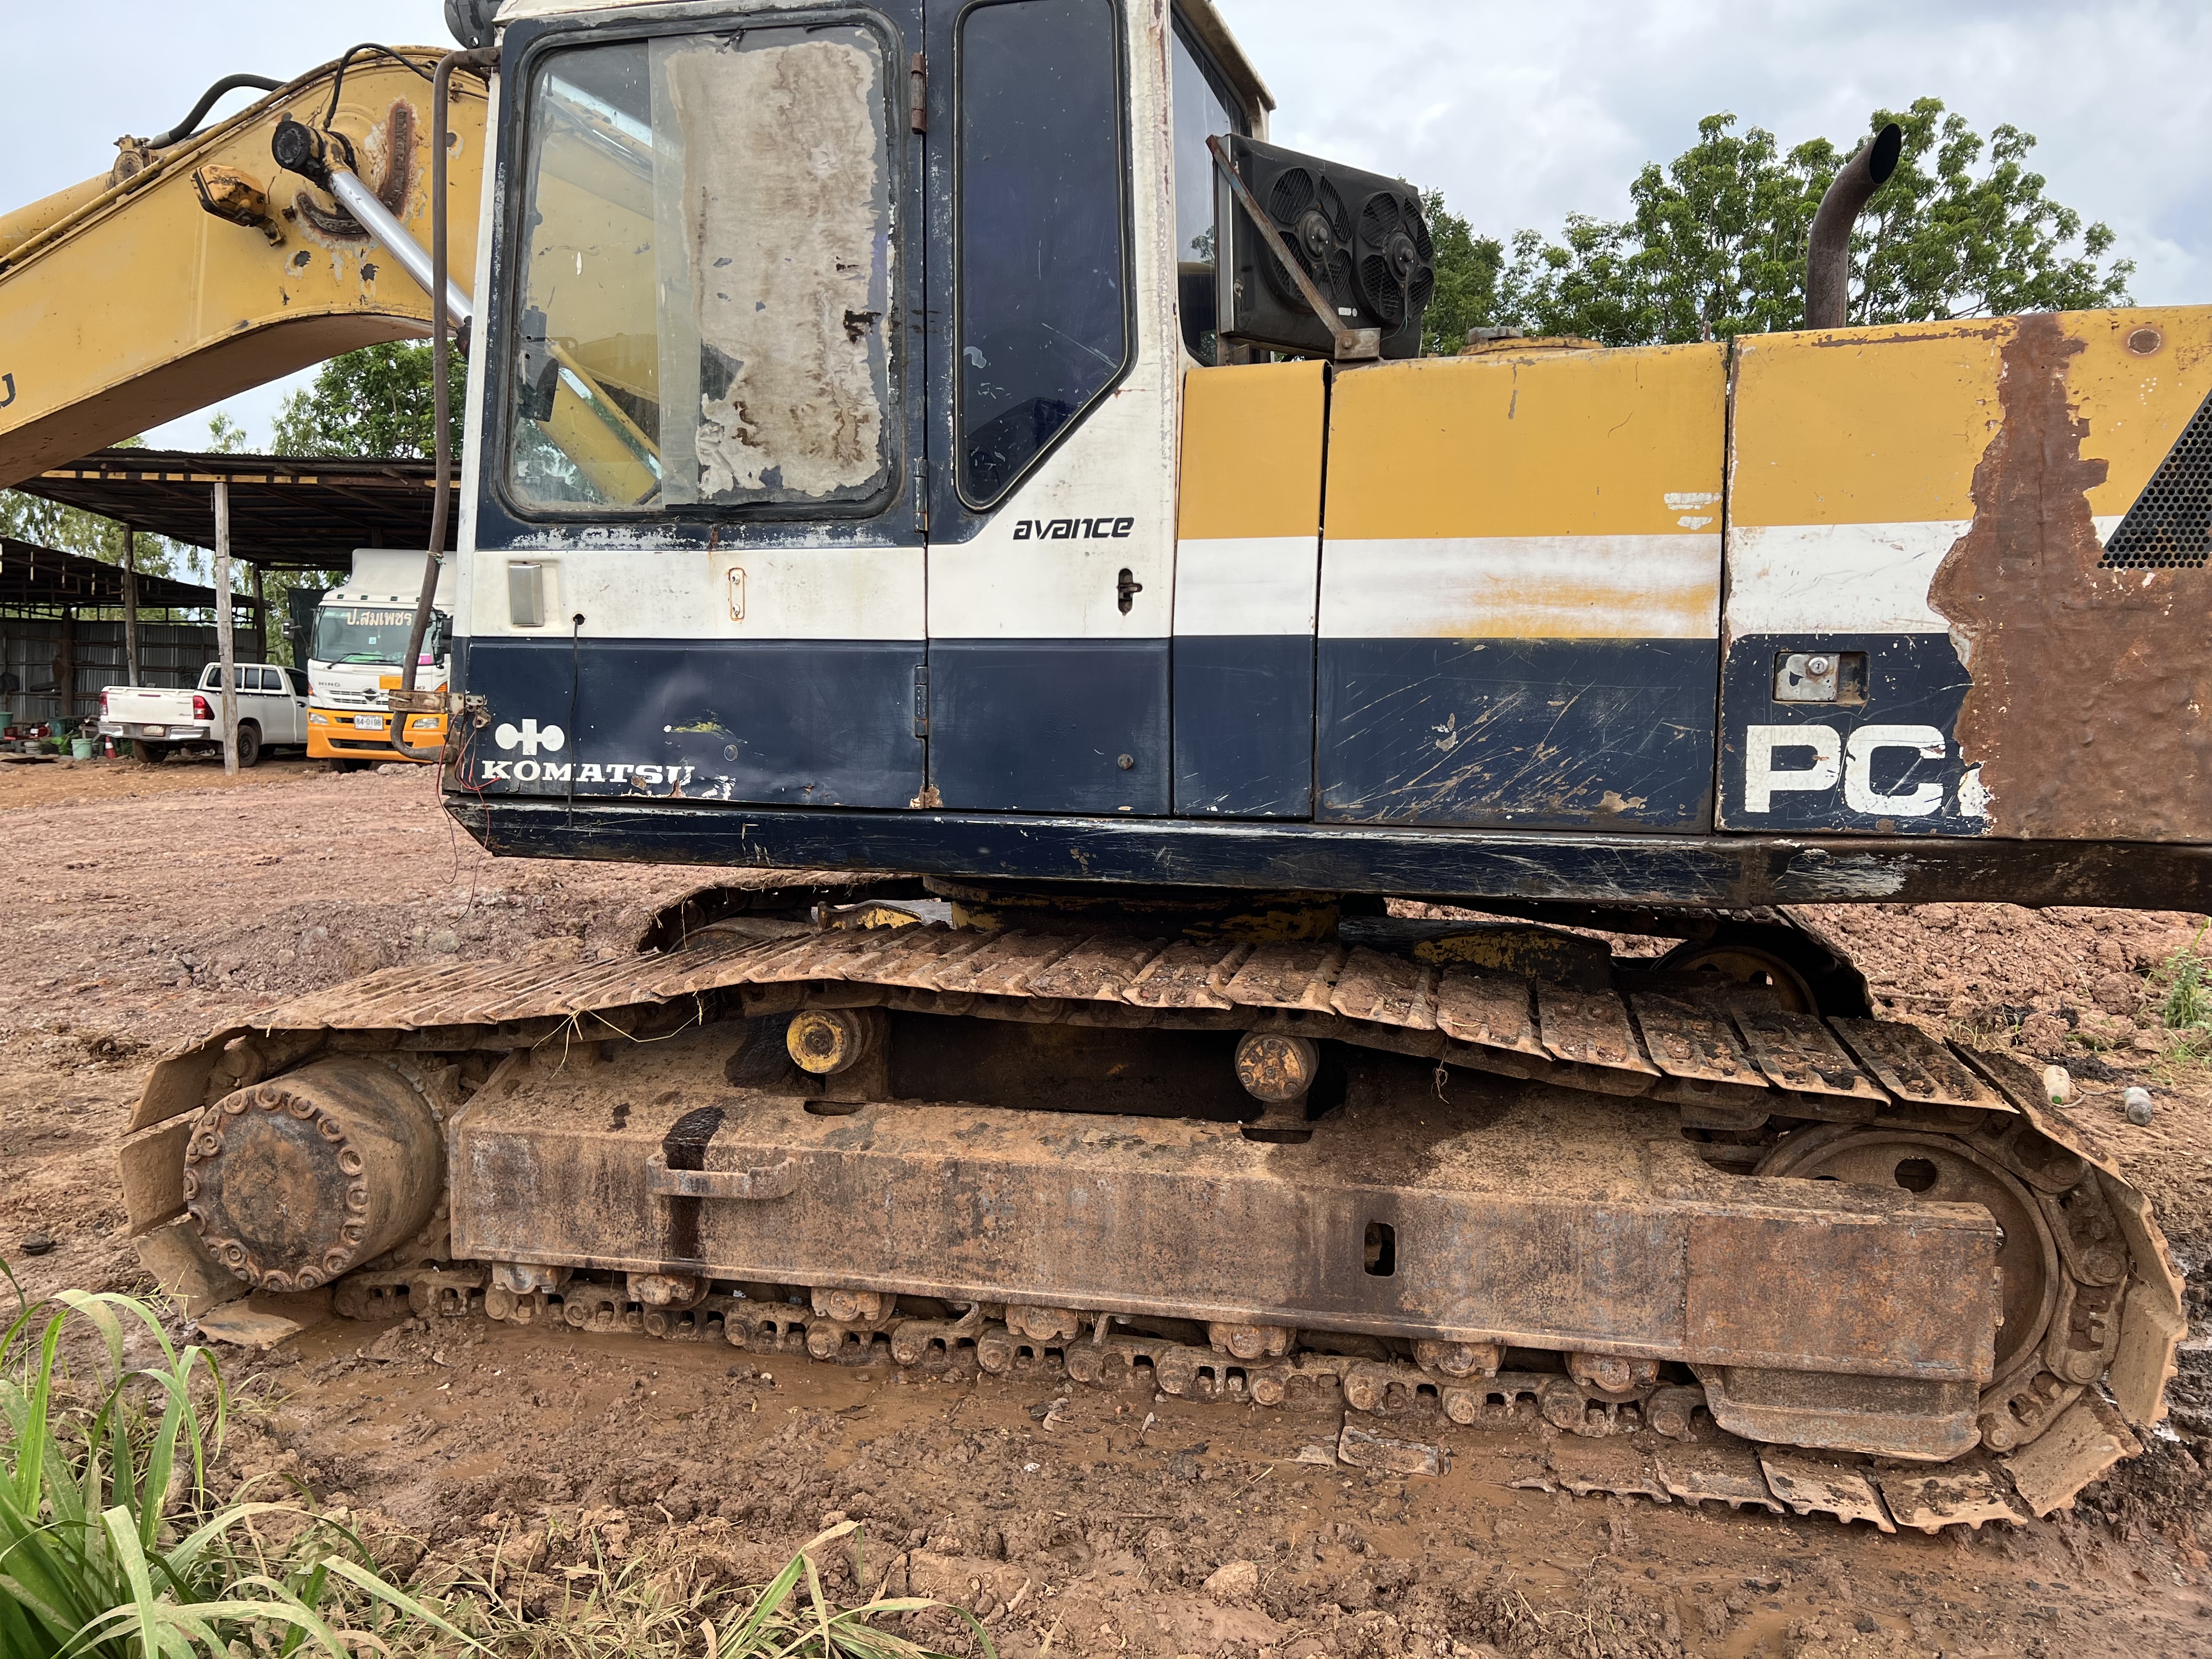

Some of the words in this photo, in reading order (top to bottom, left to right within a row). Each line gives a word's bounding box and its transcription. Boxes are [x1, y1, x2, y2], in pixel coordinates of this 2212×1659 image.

[1013, 517, 1135, 540] avance
[347, 608, 413, 626] ป.สมเพชร
[481, 760, 696, 785] KOMATSU
